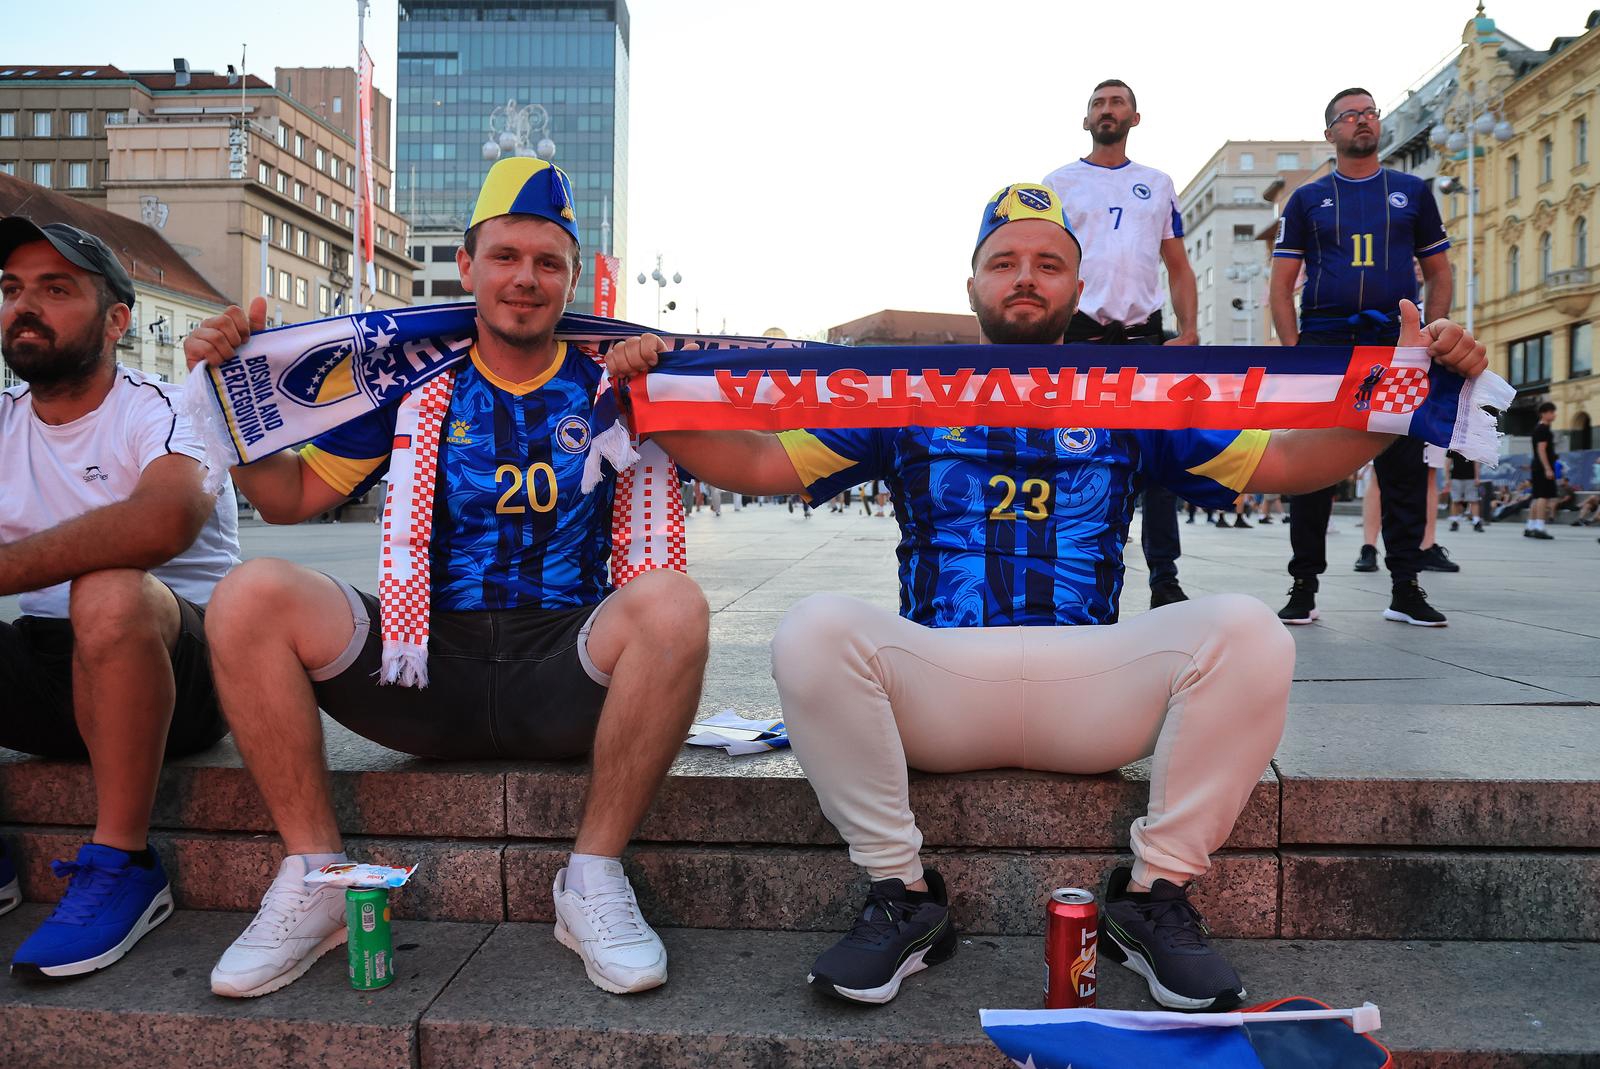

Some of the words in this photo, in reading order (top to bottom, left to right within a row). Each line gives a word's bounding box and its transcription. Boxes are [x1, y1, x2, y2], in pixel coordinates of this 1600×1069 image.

[1108, 206, 1123, 230] 7
[1350, 233, 1376, 267] 11
[218, 354, 266, 448] HERZEGOVINA
[244, 354, 275, 404] BOSNIA
[713, 366, 1140, 411] HRVATSKA
[1237, 366, 1267, 410] I
[256, 402, 284, 432] AND
[494, 461, 559, 516] 20
[988, 474, 1051, 522] 23
[1080, 928, 1097, 997] FAST
